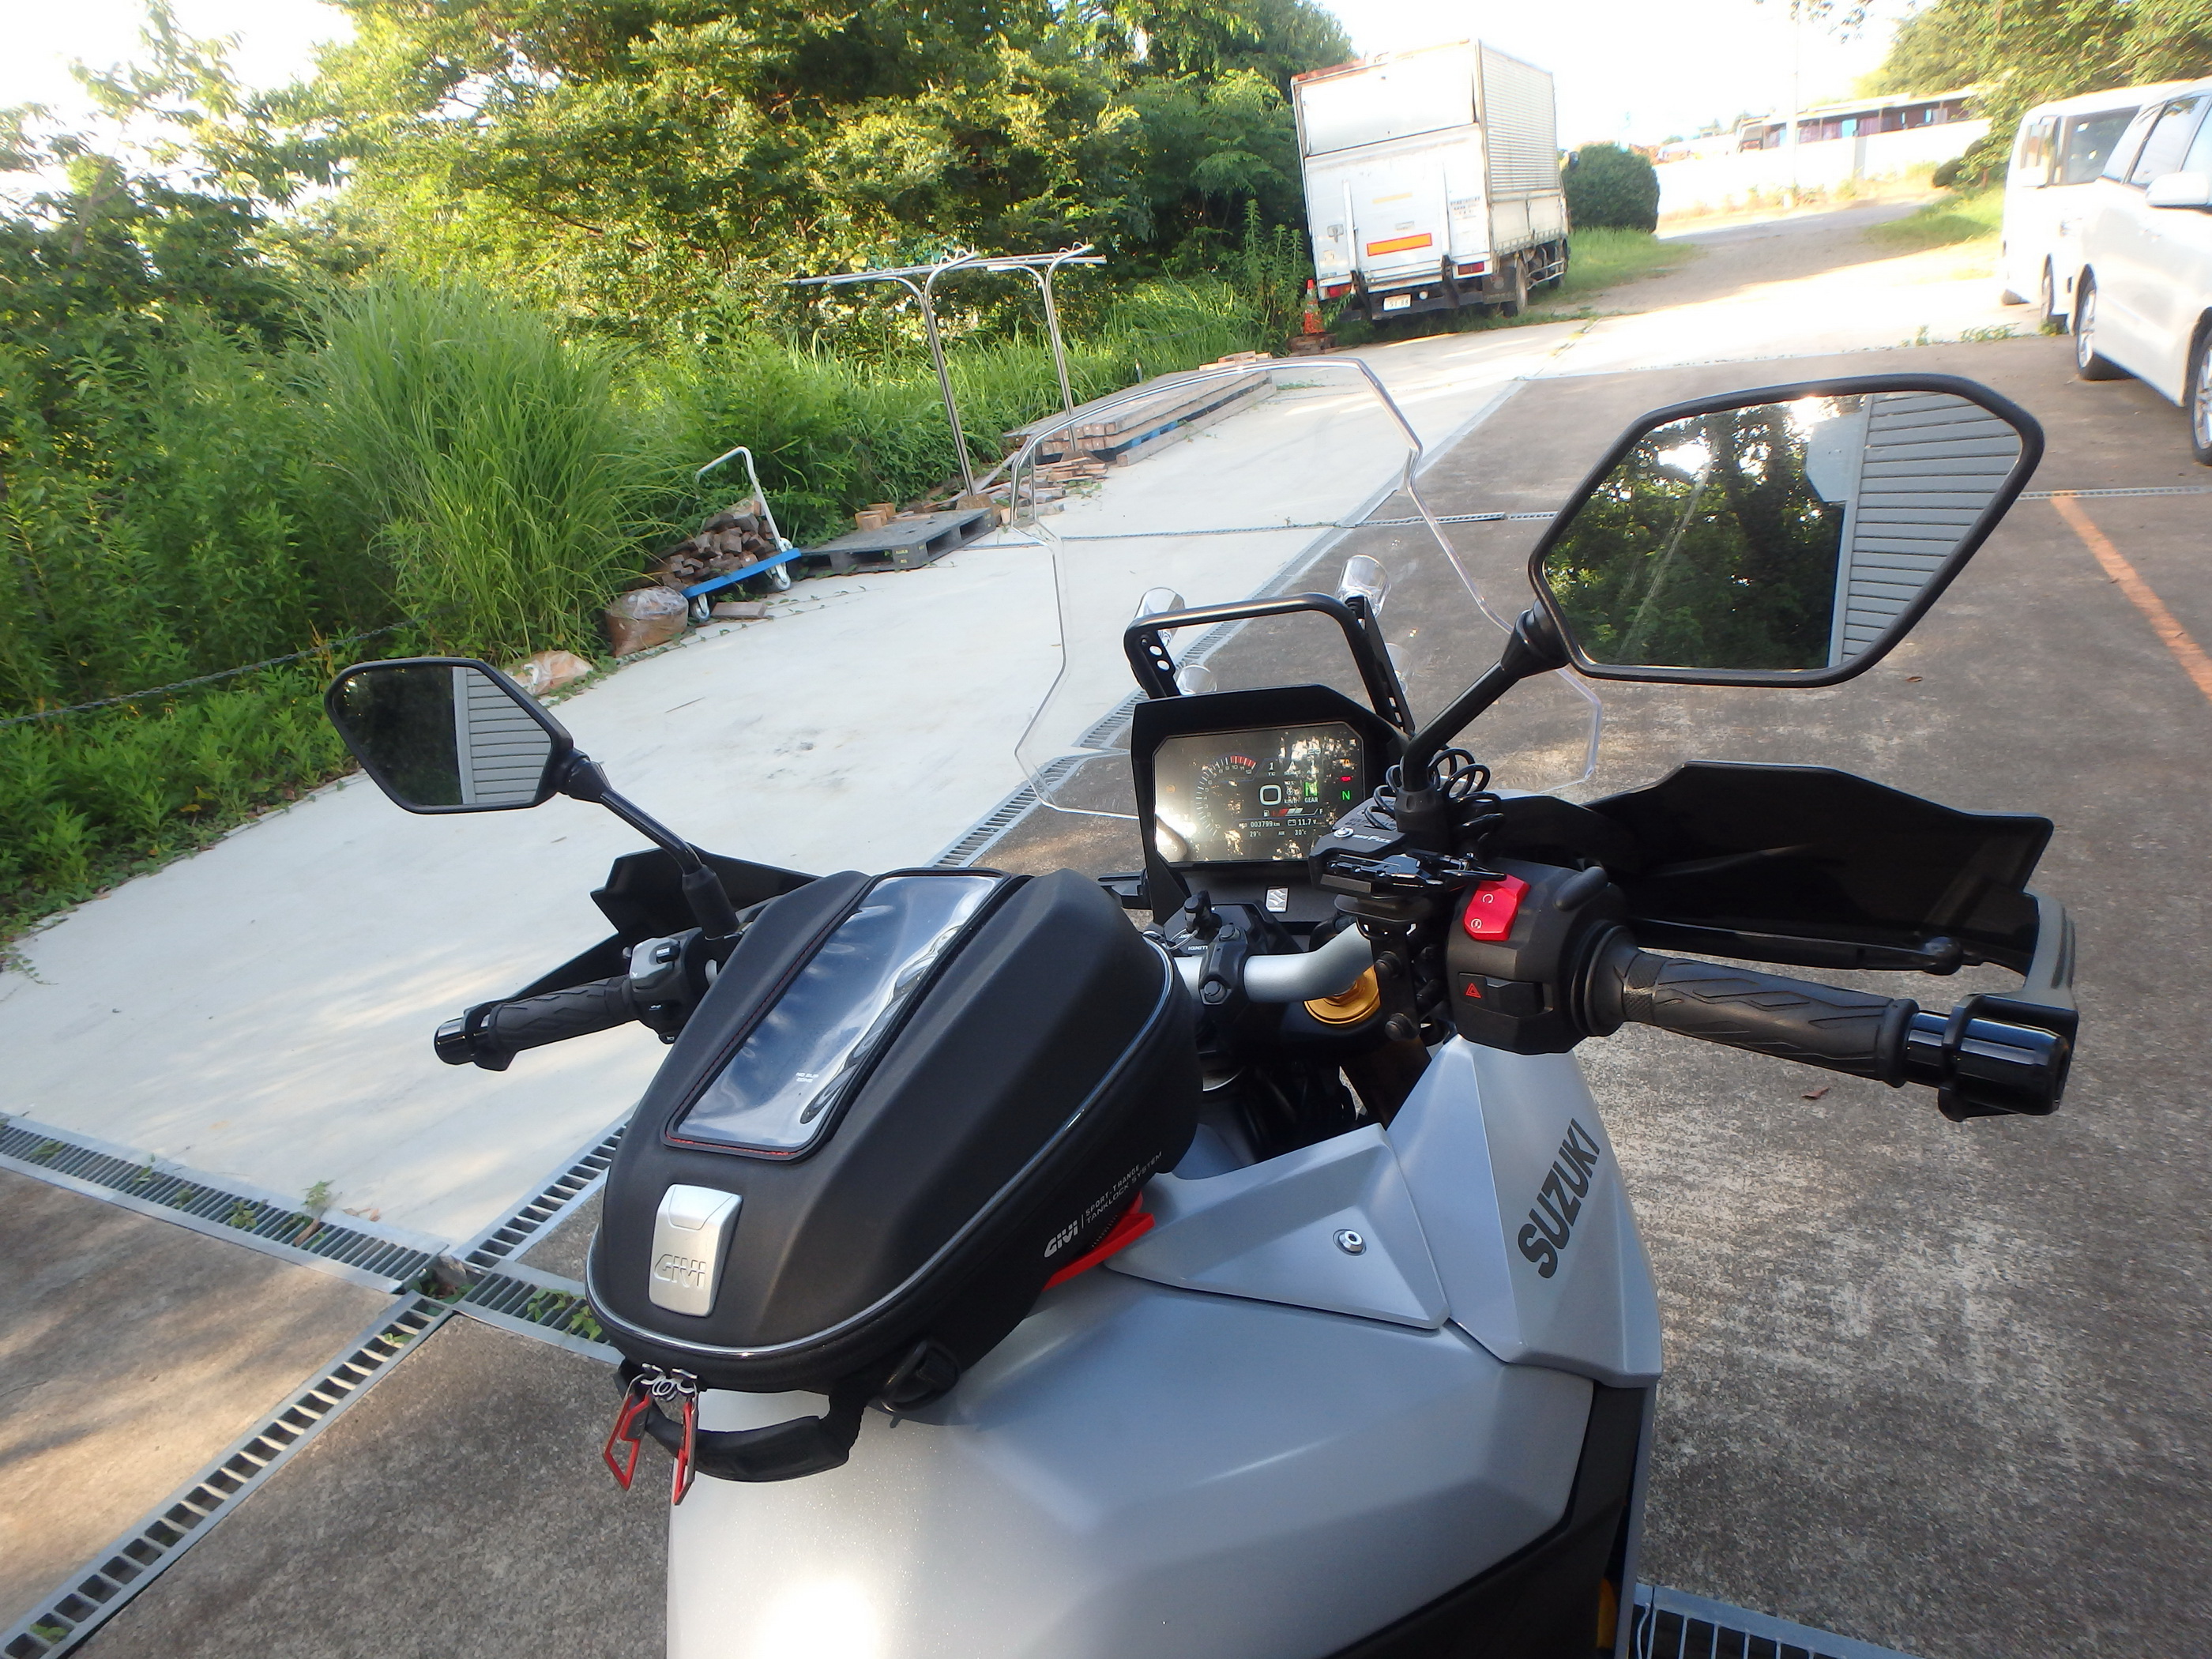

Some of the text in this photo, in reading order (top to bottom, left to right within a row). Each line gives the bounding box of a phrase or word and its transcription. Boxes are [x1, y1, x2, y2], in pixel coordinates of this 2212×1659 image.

[1304, 781, 1319, 796] N
[1342, 791, 1350, 800] N
[1086, 1151, 1162, 1224] TANKLOCK SYSTEM
[1517, 1117, 1601, 1279] SUZUKI
[1044, 1220, 1078, 1258] GIVI
[654, 1253, 707, 1289] GIVI
